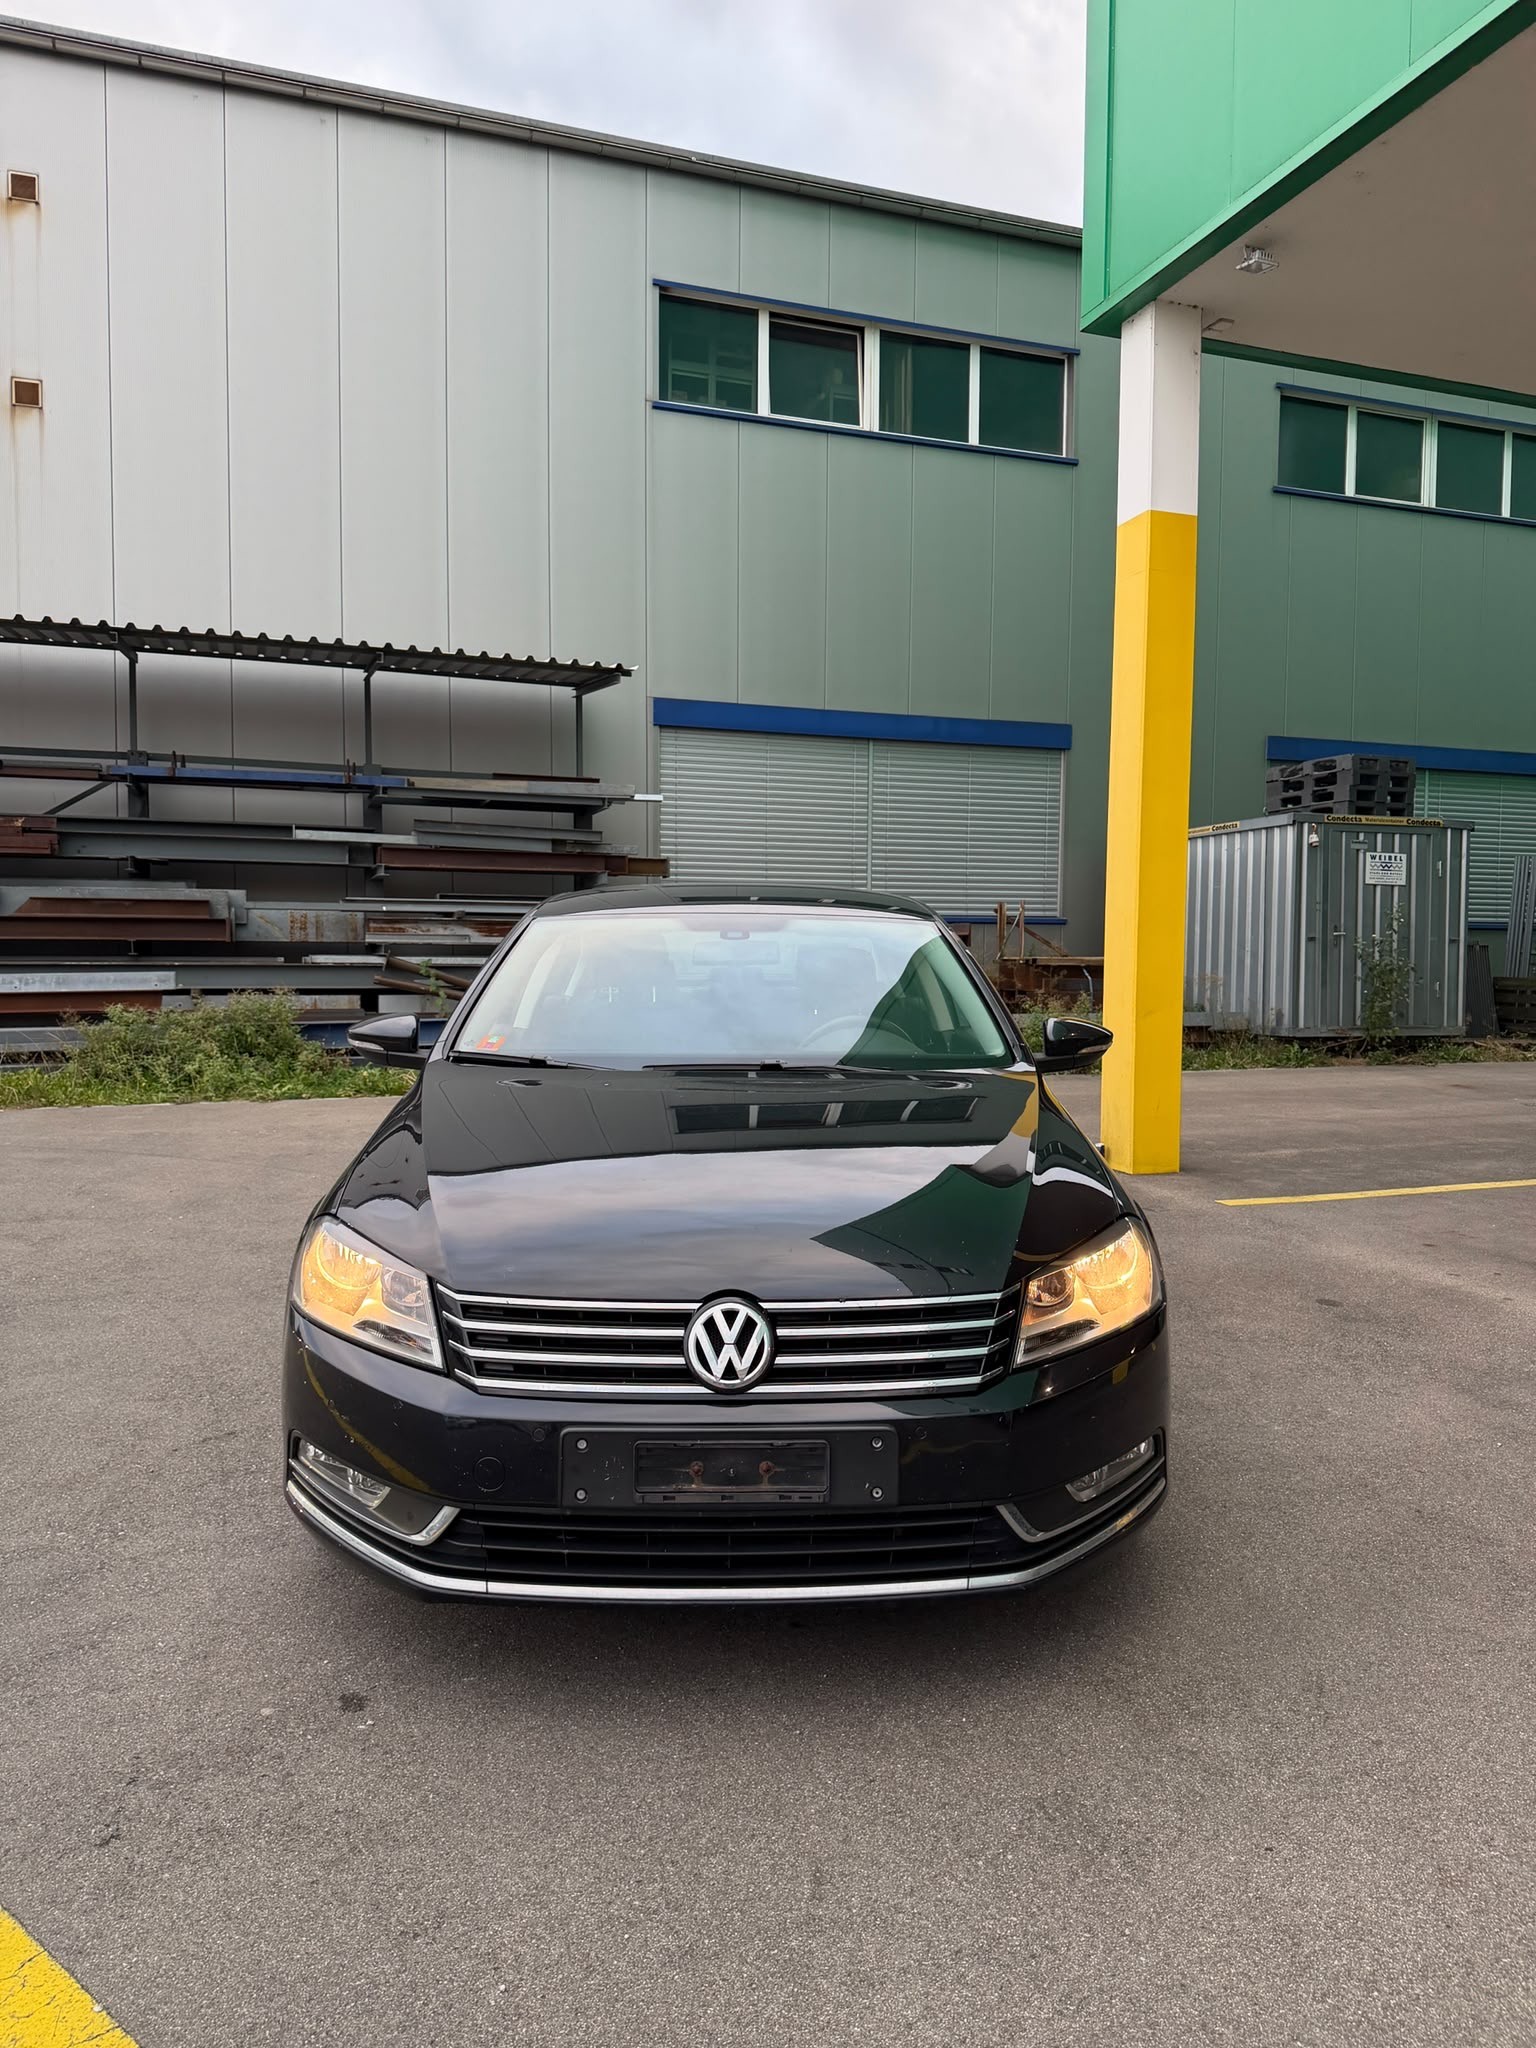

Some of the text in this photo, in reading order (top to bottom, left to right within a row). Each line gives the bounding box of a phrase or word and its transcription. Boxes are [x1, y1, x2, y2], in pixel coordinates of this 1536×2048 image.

[1326, 815, 1362, 823] Condecta
[1406, 818, 1441, 826] Condecta
[1211, 823, 1238, 831] Condecta
[1370, 854, 1403, 862] WEIBEL
[688, 1302, 770, 1384] VW
